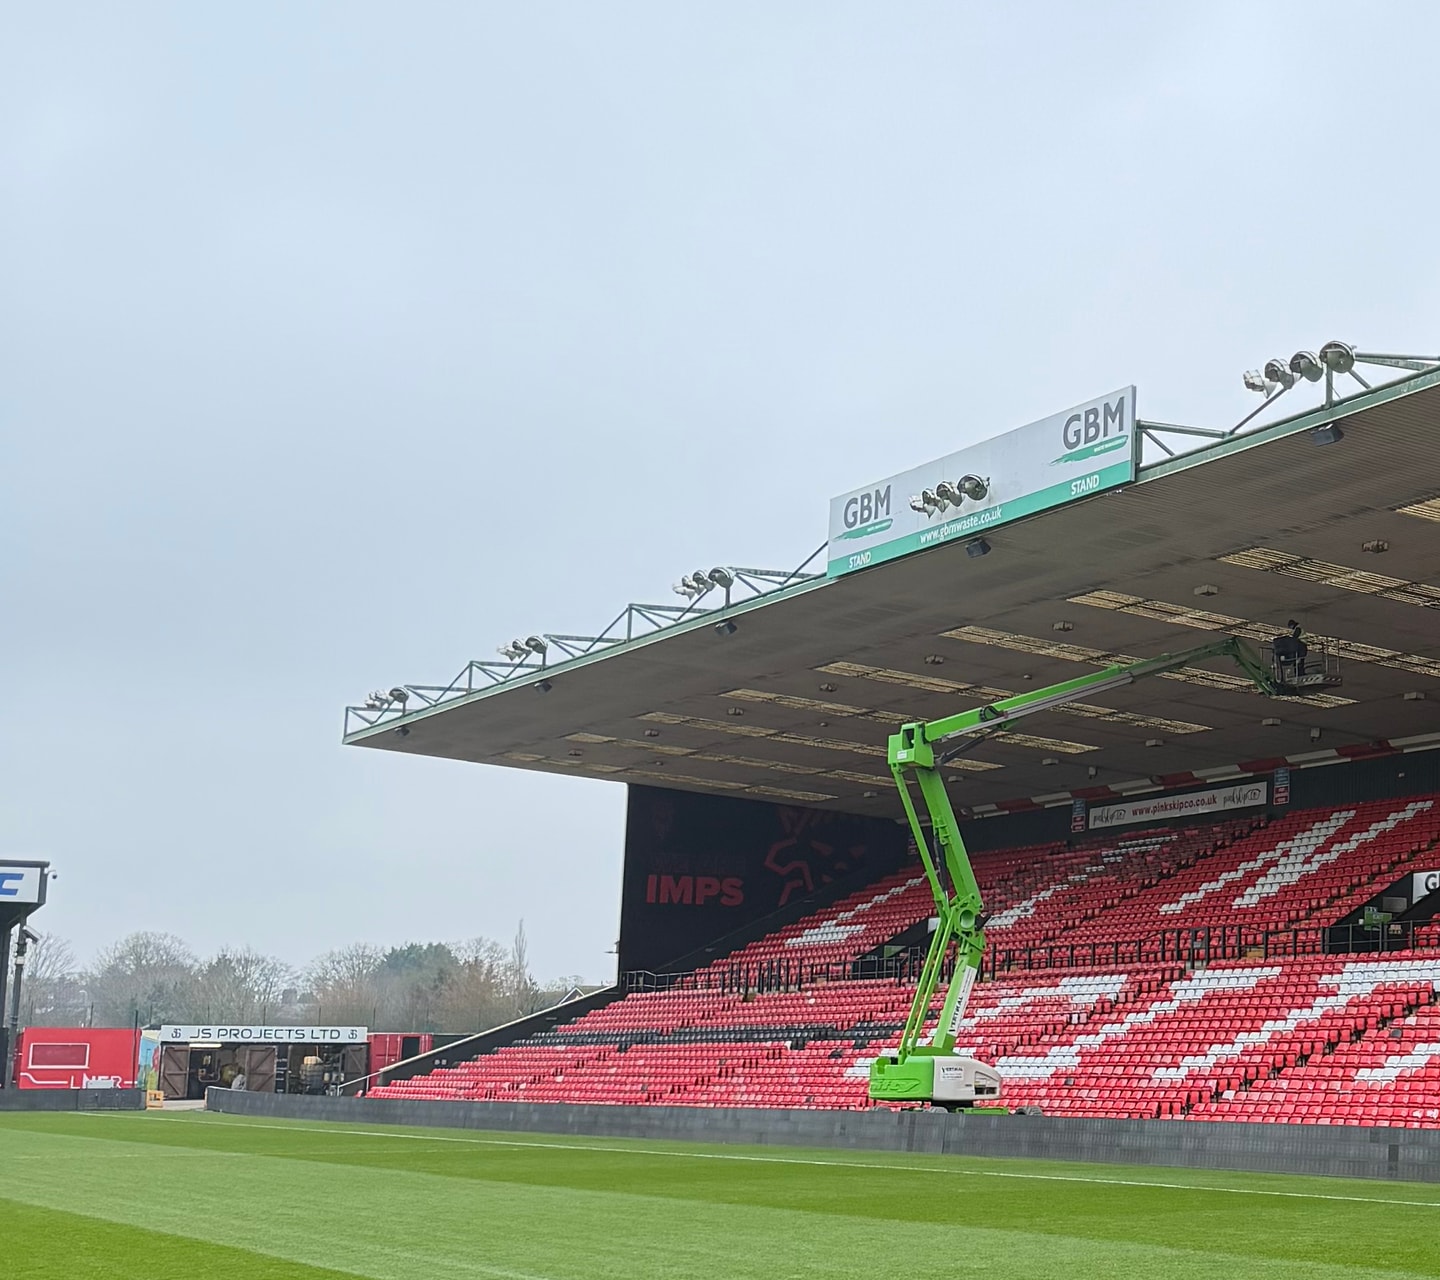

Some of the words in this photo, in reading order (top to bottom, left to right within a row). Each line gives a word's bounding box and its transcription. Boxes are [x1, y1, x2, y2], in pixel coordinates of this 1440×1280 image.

[1063, 396, 1125, 450] GBM
[1071, 474, 1100, 496] STAND
[843, 484, 891, 529] GBM
[920, 505, 1002, 544] www.gbmwaste.co.uk
[849, 551, 872, 569] STAND
[647, 874, 744, 906] IMPS
[190, 1028, 212, 1039] JS
[217, 1028, 305, 1040] PROJECTS
[311, 1029, 340, 1040] LTD
